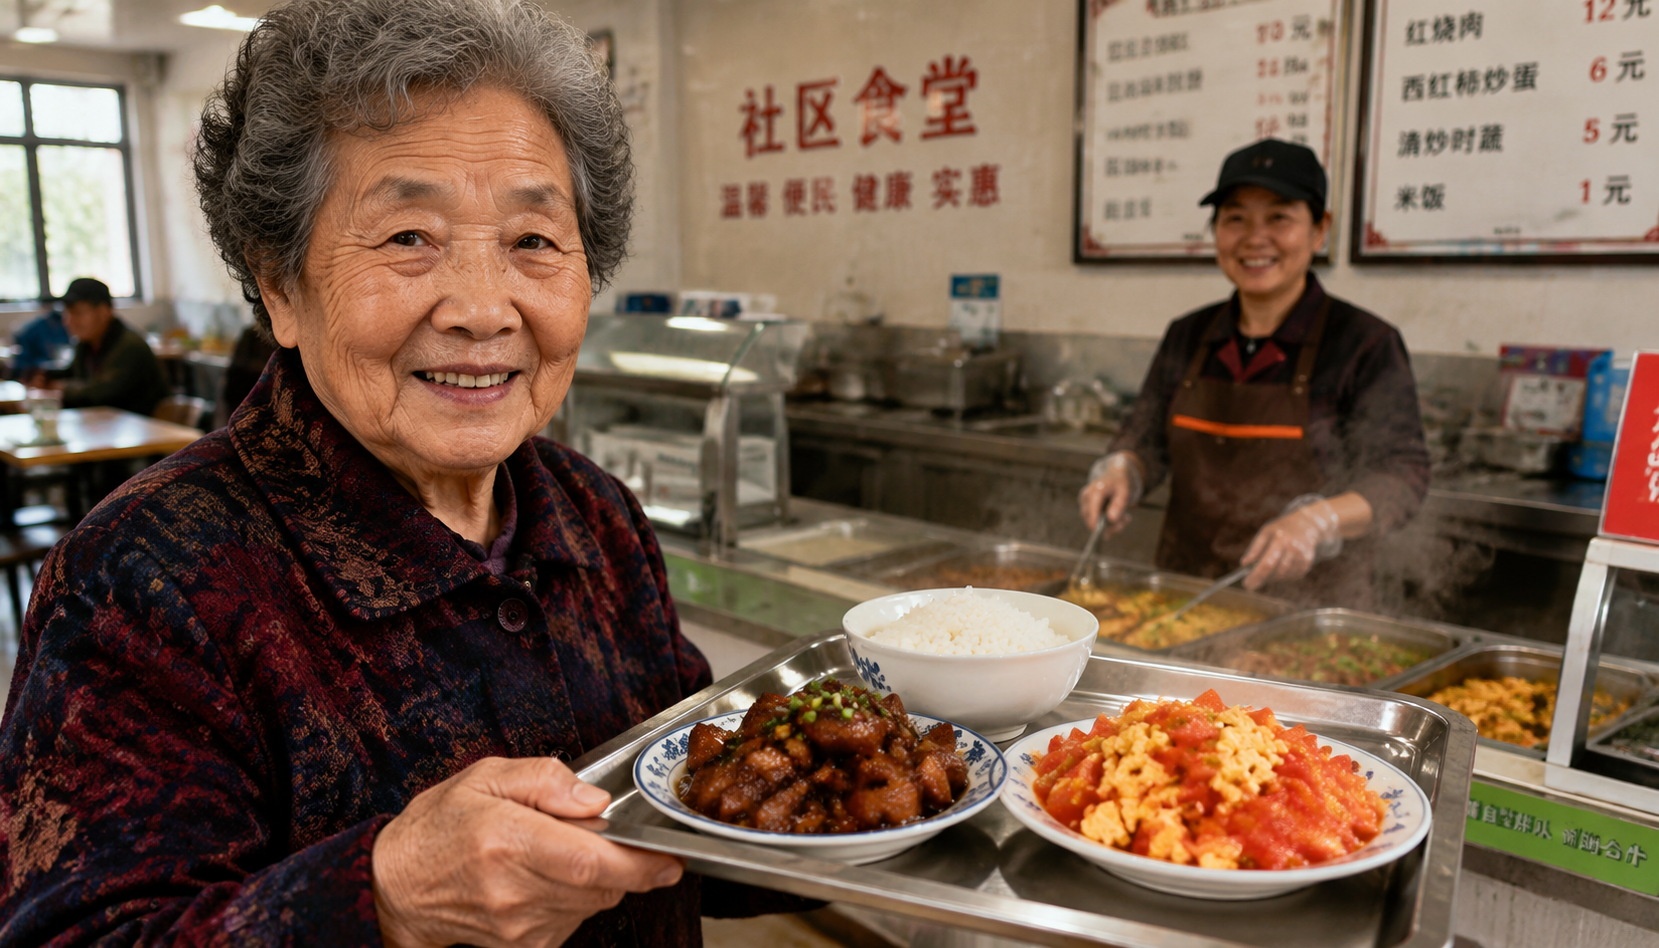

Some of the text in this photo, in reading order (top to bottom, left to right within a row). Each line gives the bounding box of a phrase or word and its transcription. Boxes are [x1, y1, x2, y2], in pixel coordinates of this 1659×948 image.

[1405, 0, 1651, 45] 红烧肉 12 元
[1589, 55, 1607, 82] 6
[1616, 50, 1645, 82] 元
[739, 54, 979, 159] 社区食堂
[1398, 112, 1638, 157] 清炒时蔬 5 元
[783, 178, 836, 216] 便民
[853, 170, 912, 212] 健康
[932, 163, 1000, 209] 实惠
[1395, 174, 1631, 212] 米饭 1 元
